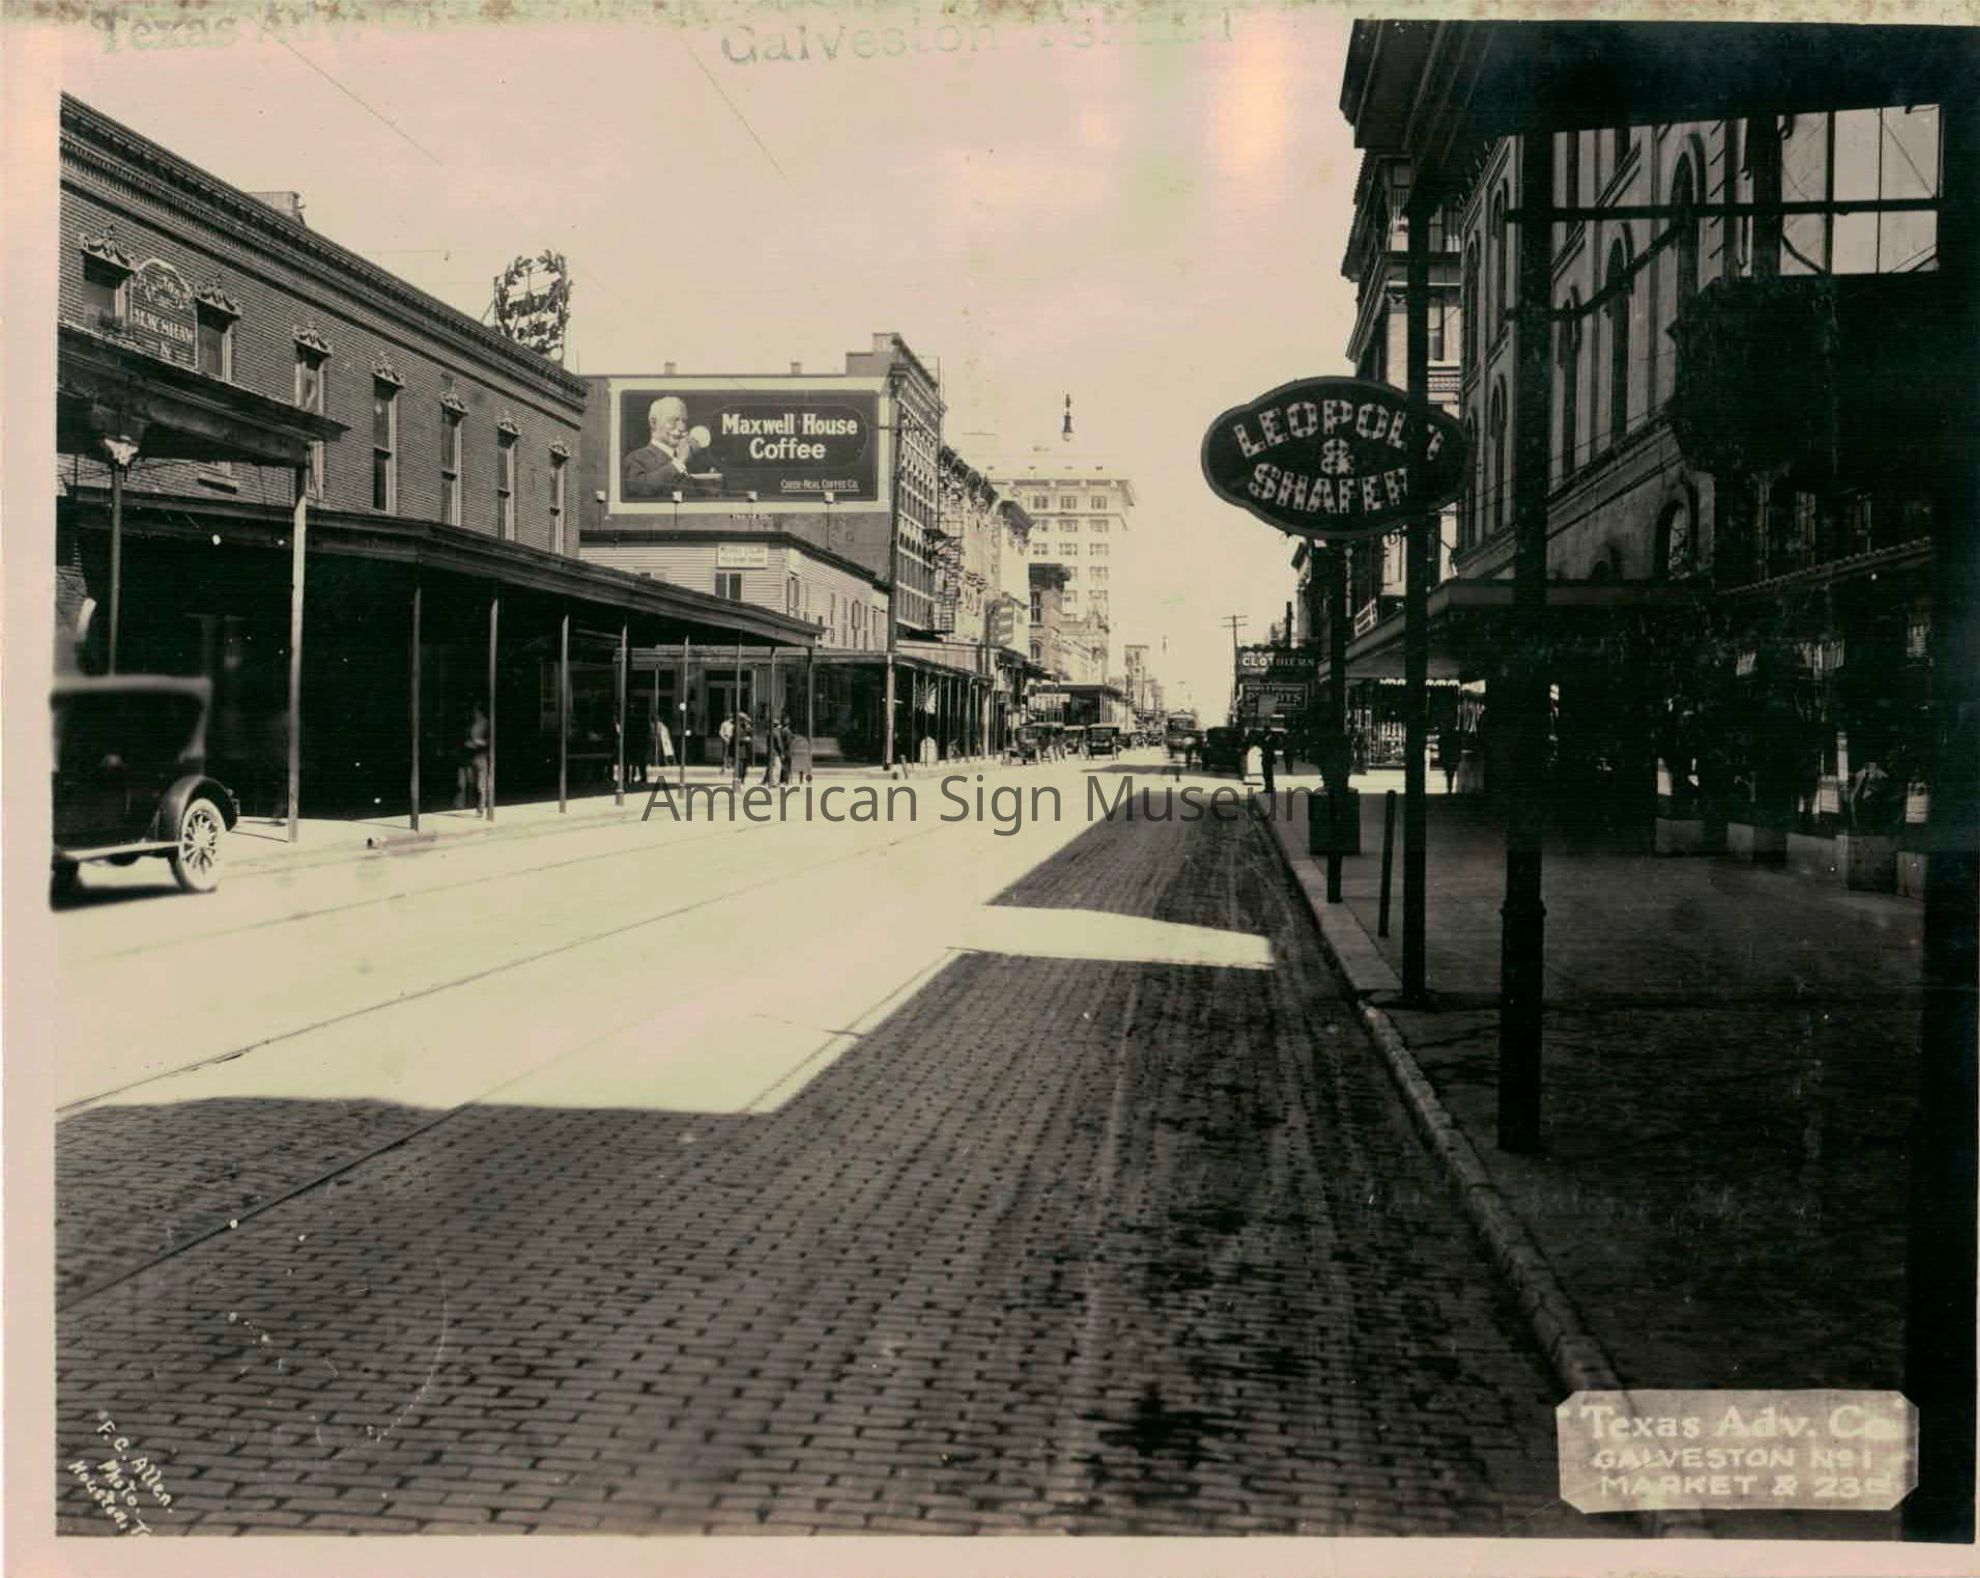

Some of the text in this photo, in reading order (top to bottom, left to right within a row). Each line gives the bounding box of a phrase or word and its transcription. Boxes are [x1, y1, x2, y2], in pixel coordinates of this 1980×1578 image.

[721, 413, 858, 435] Maxwell House
[749, 437, 827, 460] Coffee
[1320, 438, 1355, 475] &
